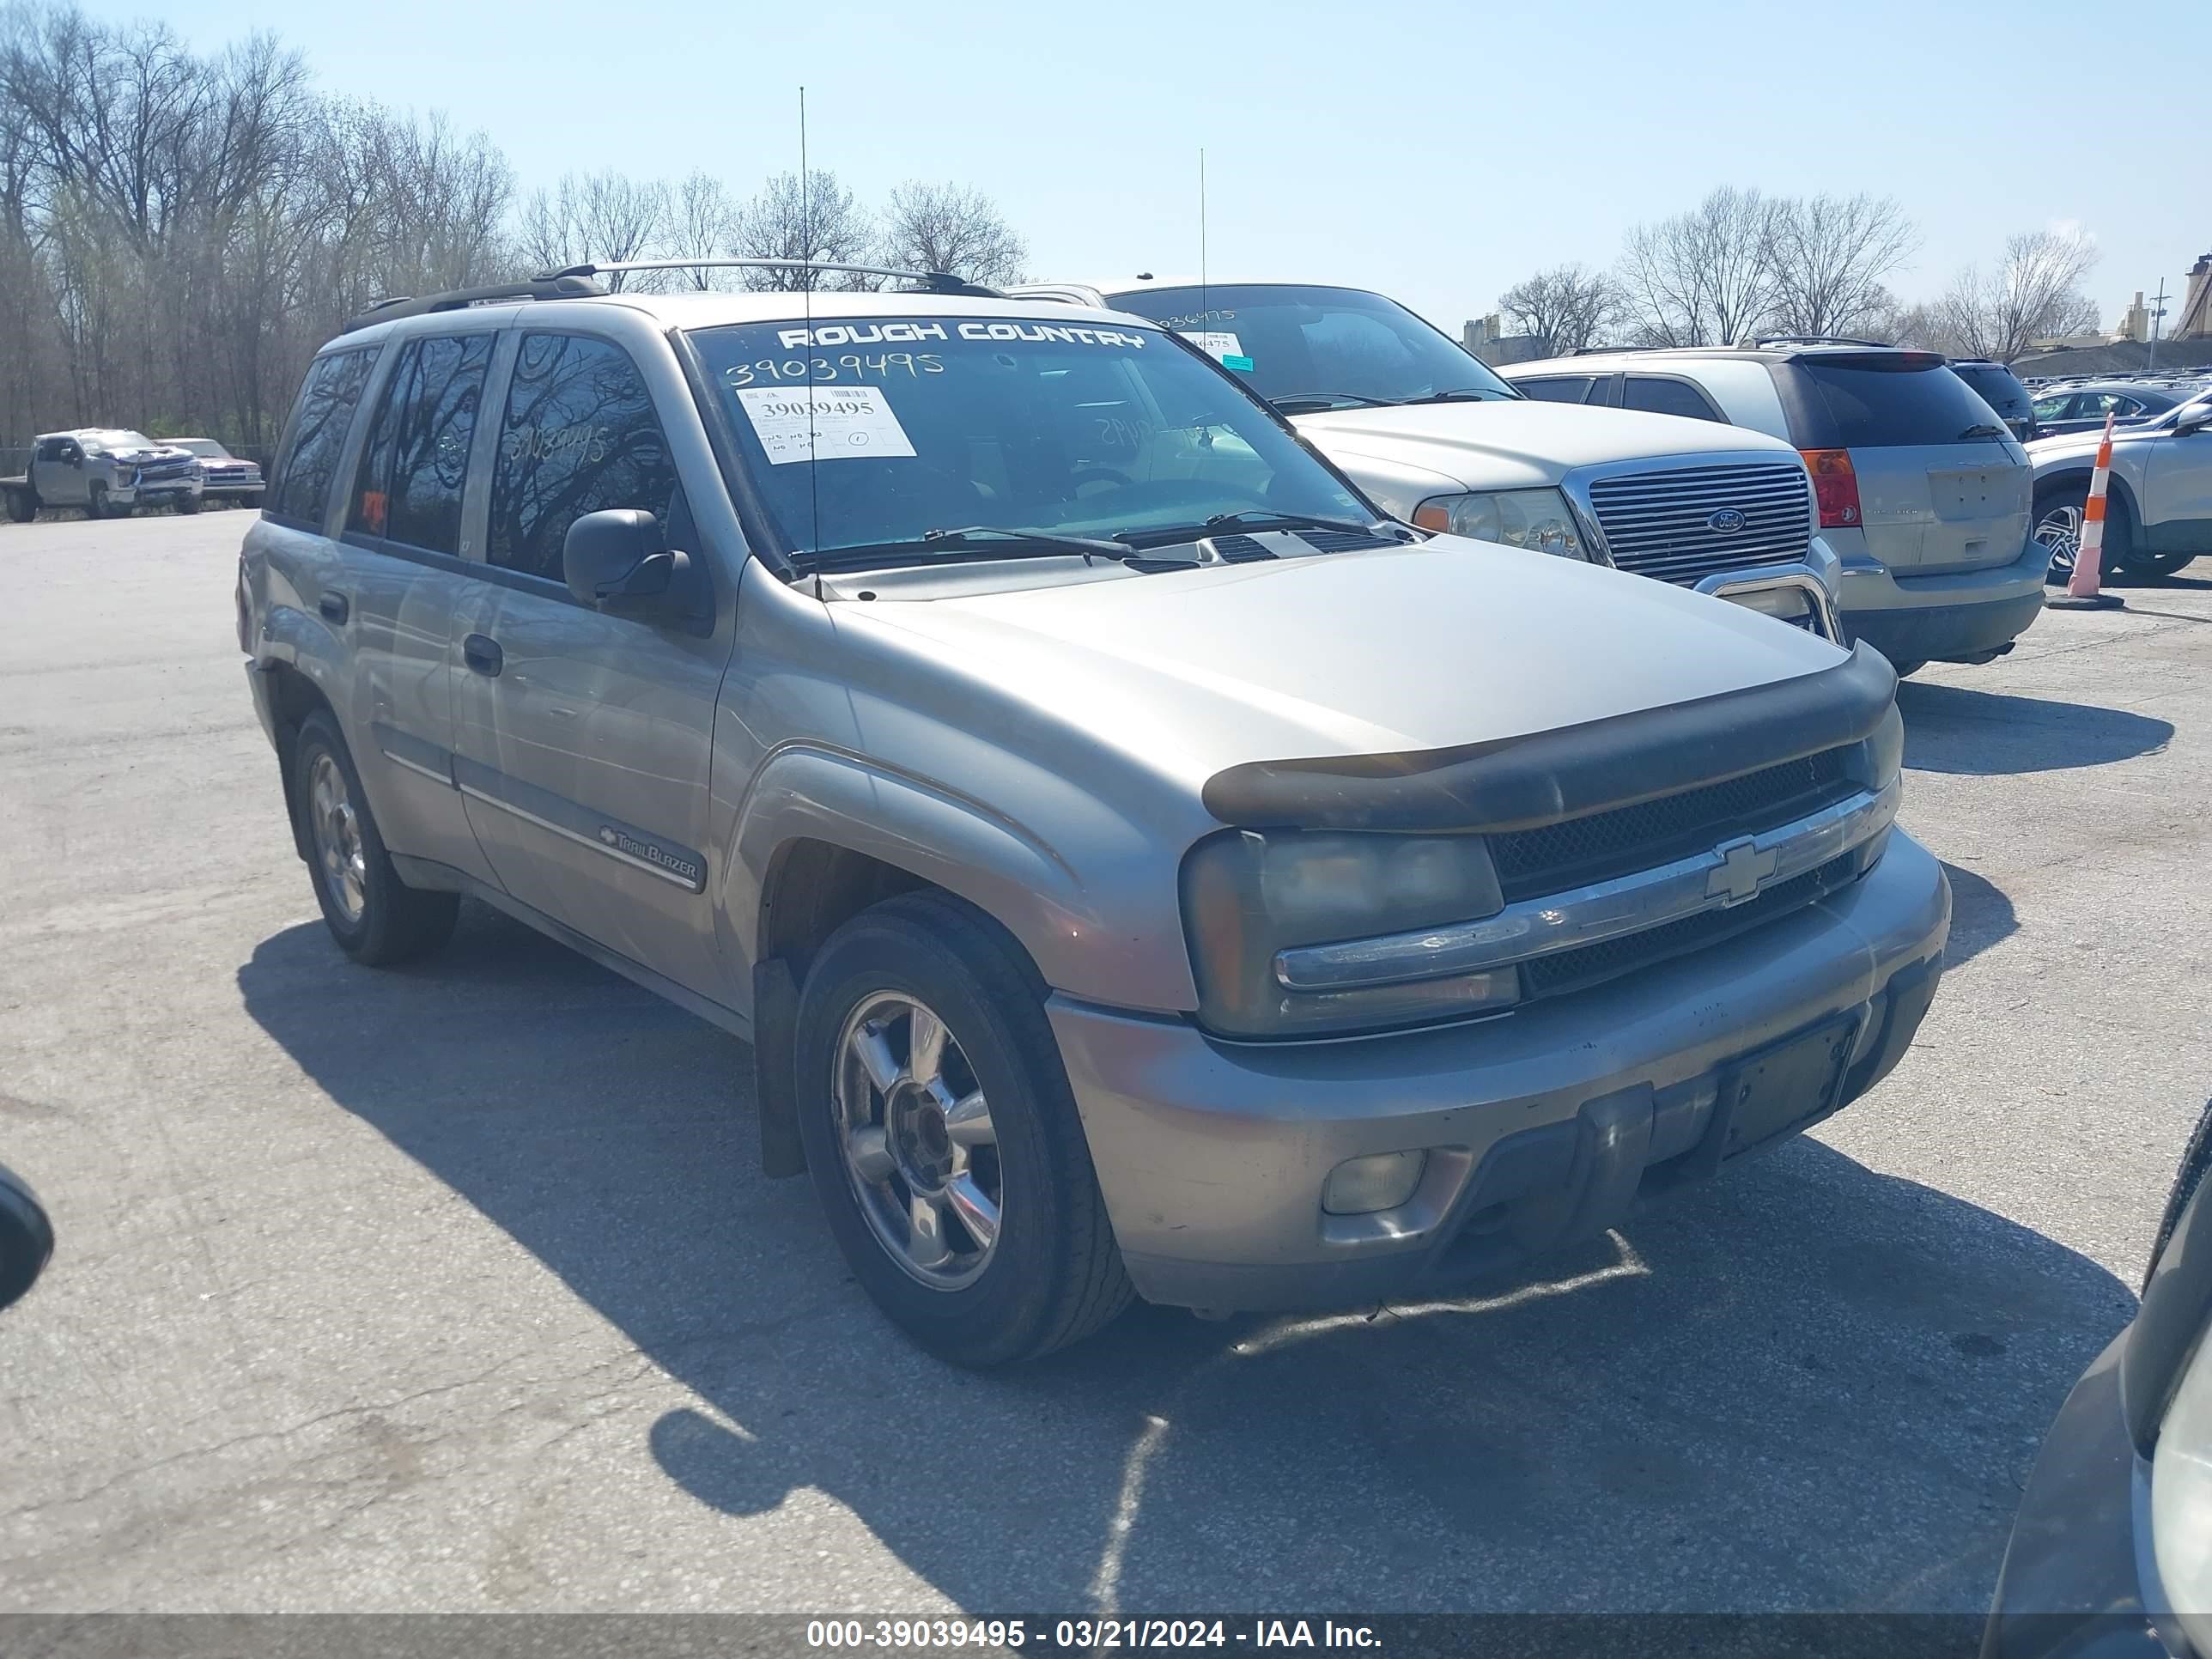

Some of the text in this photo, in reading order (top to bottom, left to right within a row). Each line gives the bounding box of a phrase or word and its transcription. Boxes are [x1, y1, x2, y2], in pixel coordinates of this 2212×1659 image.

[777, 323, 1146, 349] ROUGH COUNTRY
[726, 352, 945, 386] 39039495
[761, 401, 874, 418] 39039495
